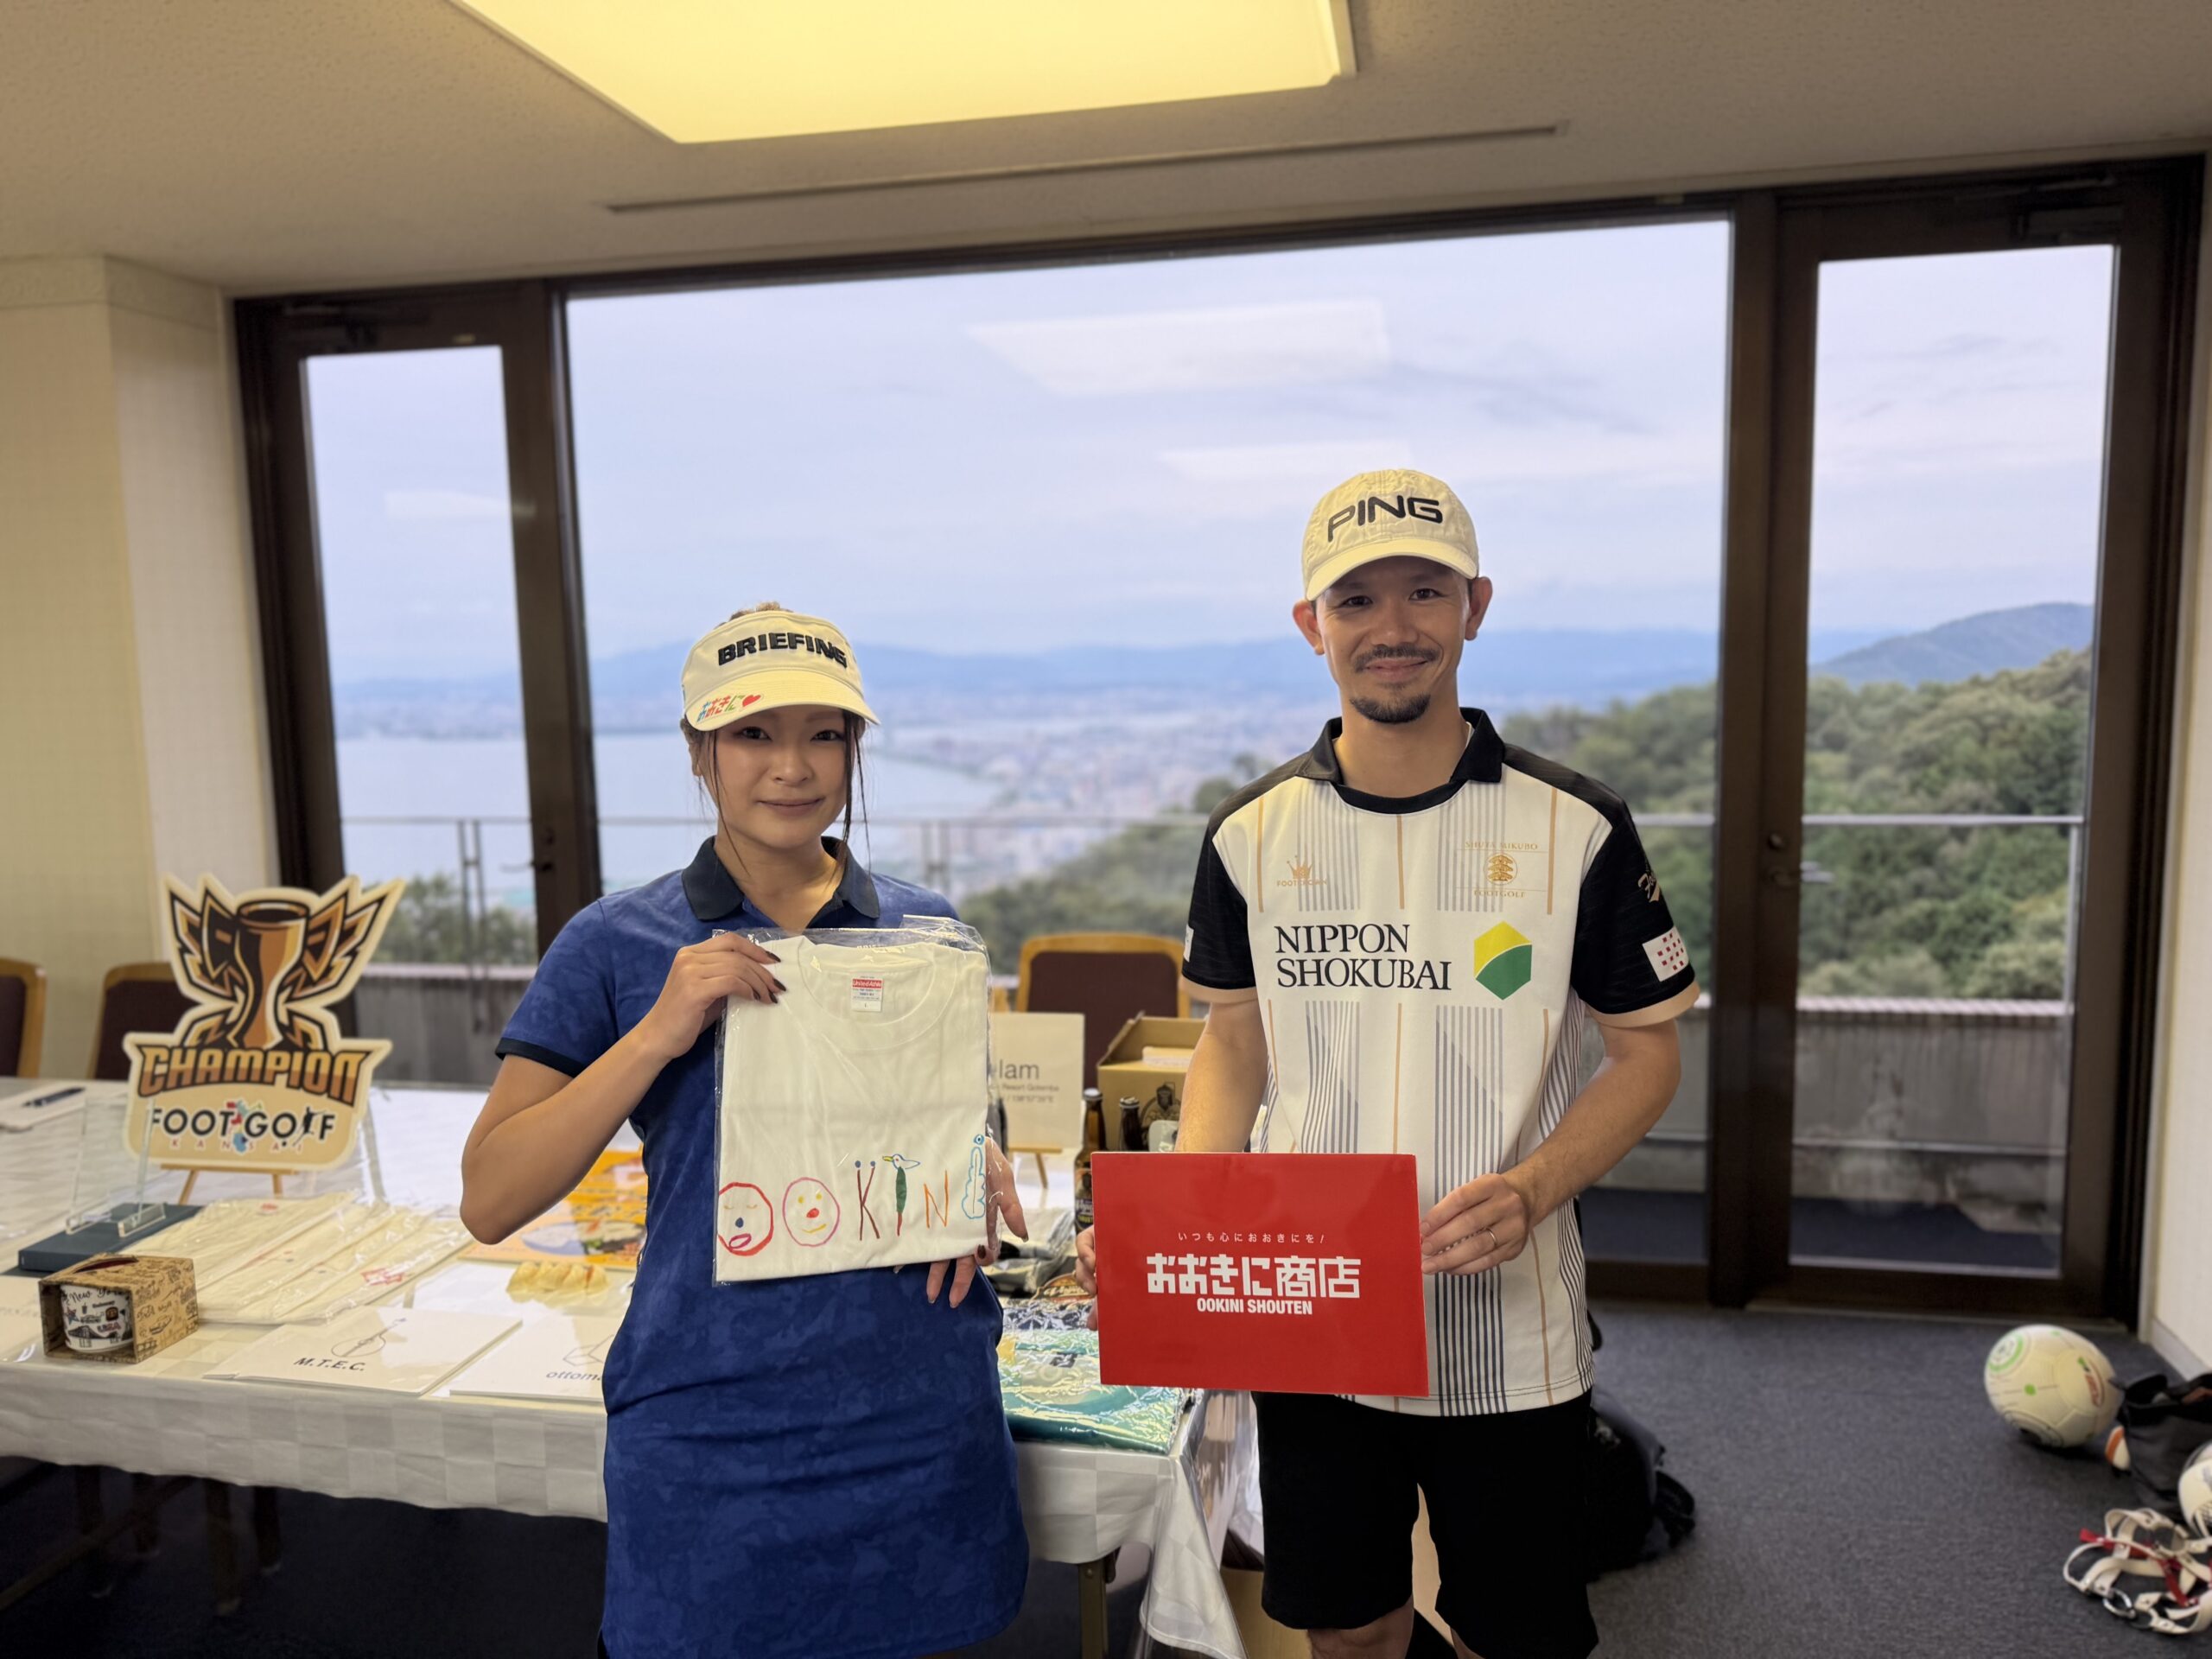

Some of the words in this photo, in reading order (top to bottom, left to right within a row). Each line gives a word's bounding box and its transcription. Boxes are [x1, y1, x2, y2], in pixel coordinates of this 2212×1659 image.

[1327, 495, 1443, 543] PING
[718, 632, 848, 668] BRIEFING
[1274, 924, 1410, 954] NIPPON
[1276, 957, 1452, 991] SHOKUBAI
[137, 1044, 372, 1108] CHAMPION
[1147, 1253, 1362, 1299] おおきに商店
[1197, 1298, 1244, 1313] OOKINI
[1247, 1299, 1313, 1315] SHOUTEN
[294, 1357, 365, 1371] M.T.E.C.
